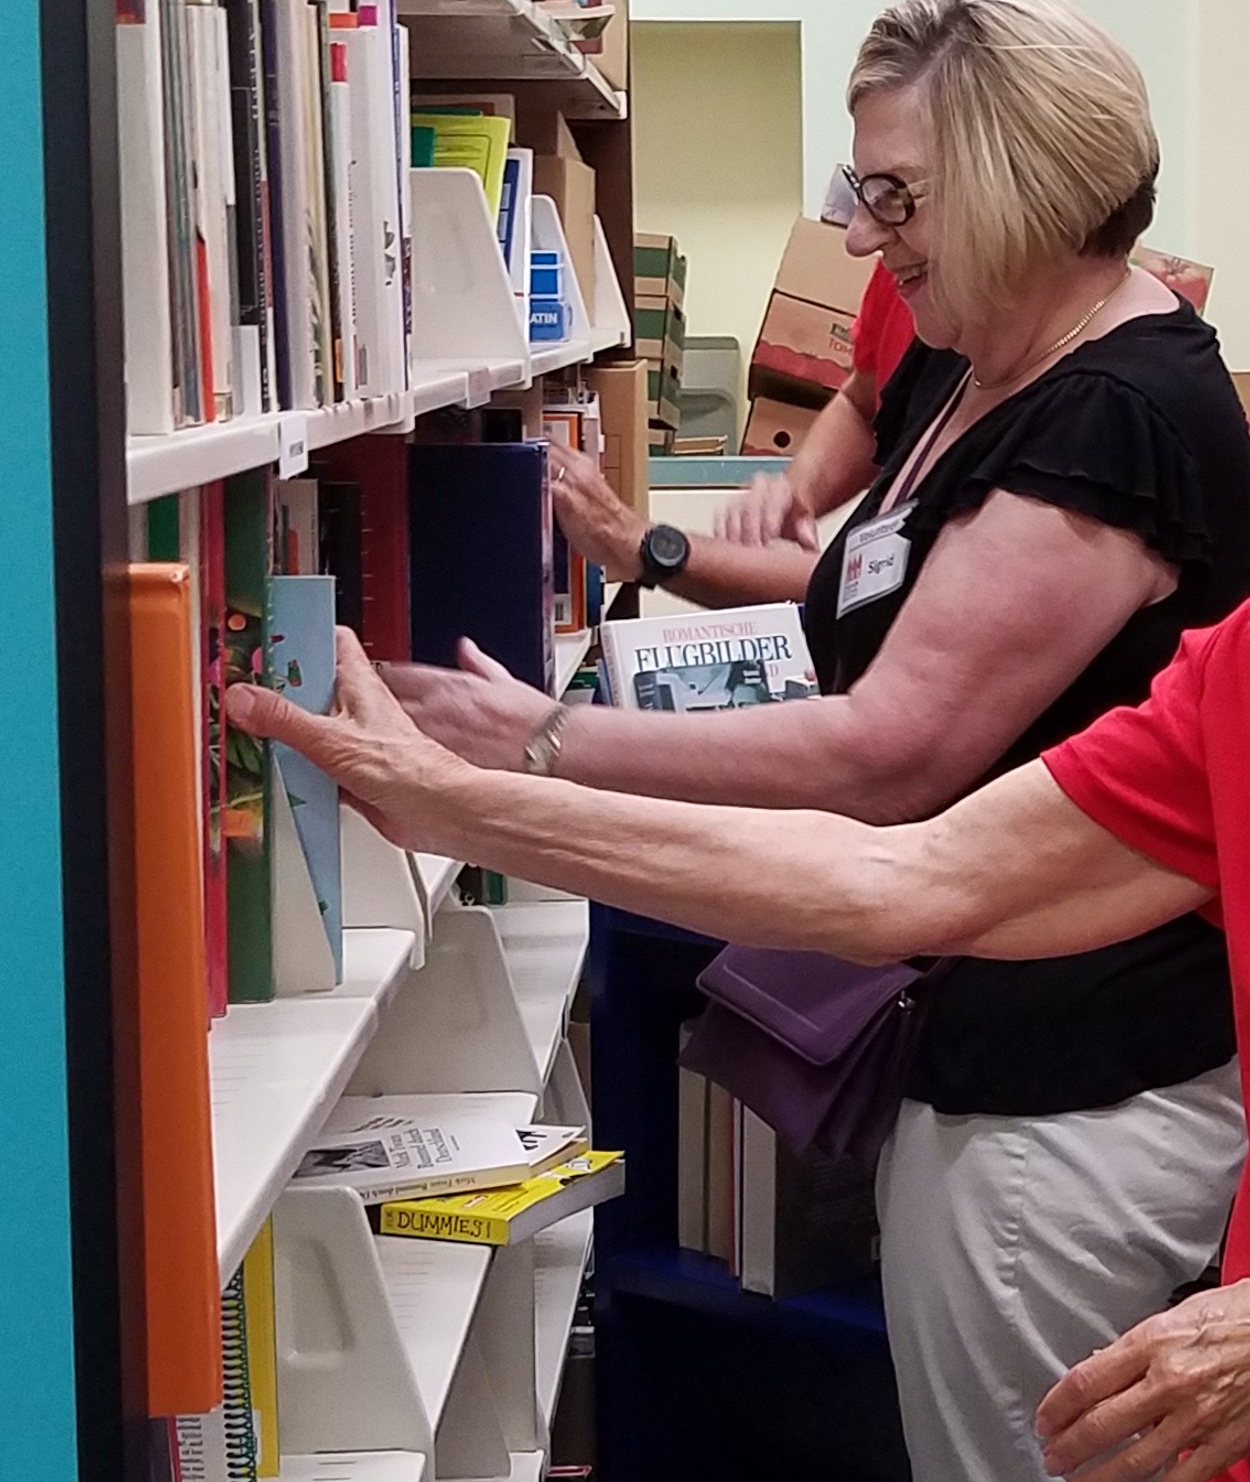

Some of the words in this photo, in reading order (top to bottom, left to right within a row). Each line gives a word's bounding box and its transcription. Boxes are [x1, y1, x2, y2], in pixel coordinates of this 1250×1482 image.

[867, 553, 895, 575] Sigrid
[662, 621, 757, 643] ROMANTISCHE
[635, 635, 793, 672] FLUGBILDER
